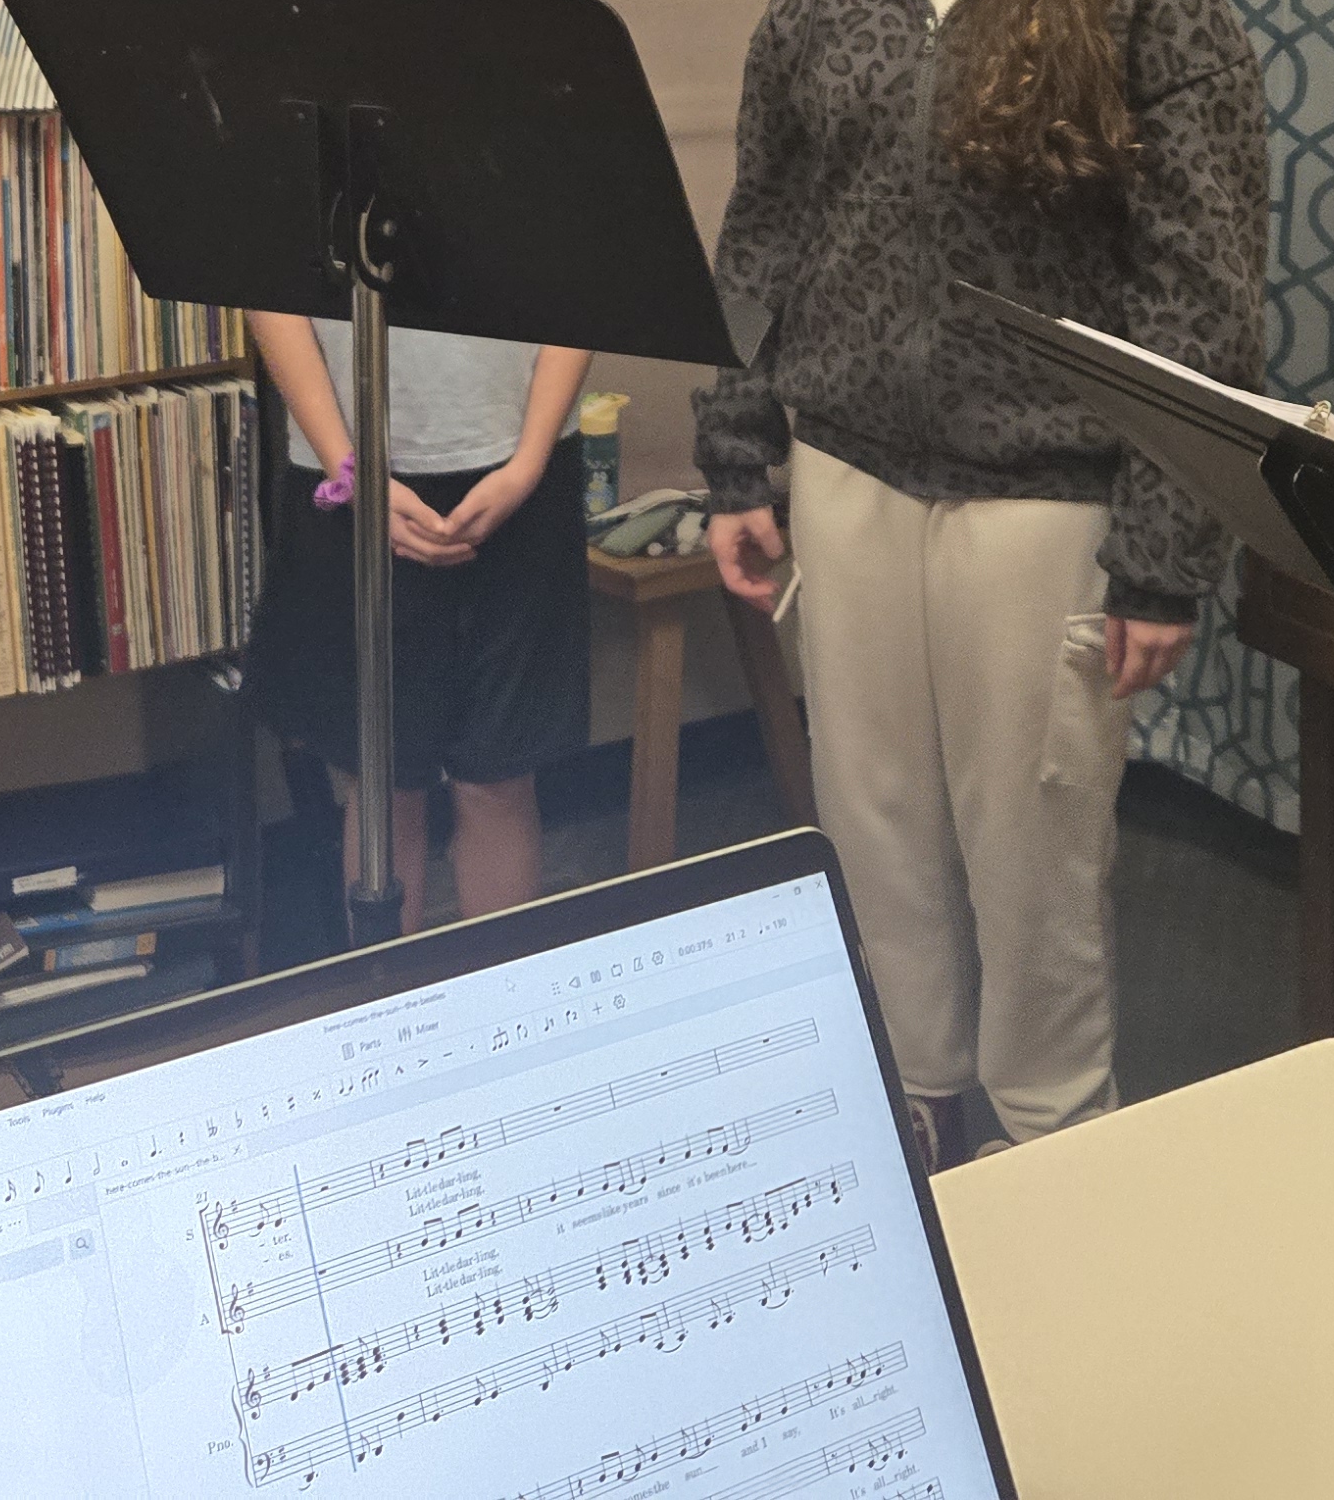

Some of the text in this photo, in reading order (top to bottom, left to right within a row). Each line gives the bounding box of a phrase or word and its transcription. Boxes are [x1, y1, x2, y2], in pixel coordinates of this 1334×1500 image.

[7, 1115, 31, 1128] Tools
[42, 1102, 75, 1118] Plugins
[85, 1093, 106, 1106] Help
[195, 1190, 209, 1204] 21
[185, 1229, 195, 1241] S
[200, 1313, 210, 1326] A
[829, 1405, 846, 1421] It's
[207, 1439, 234, 1455] Pno.
